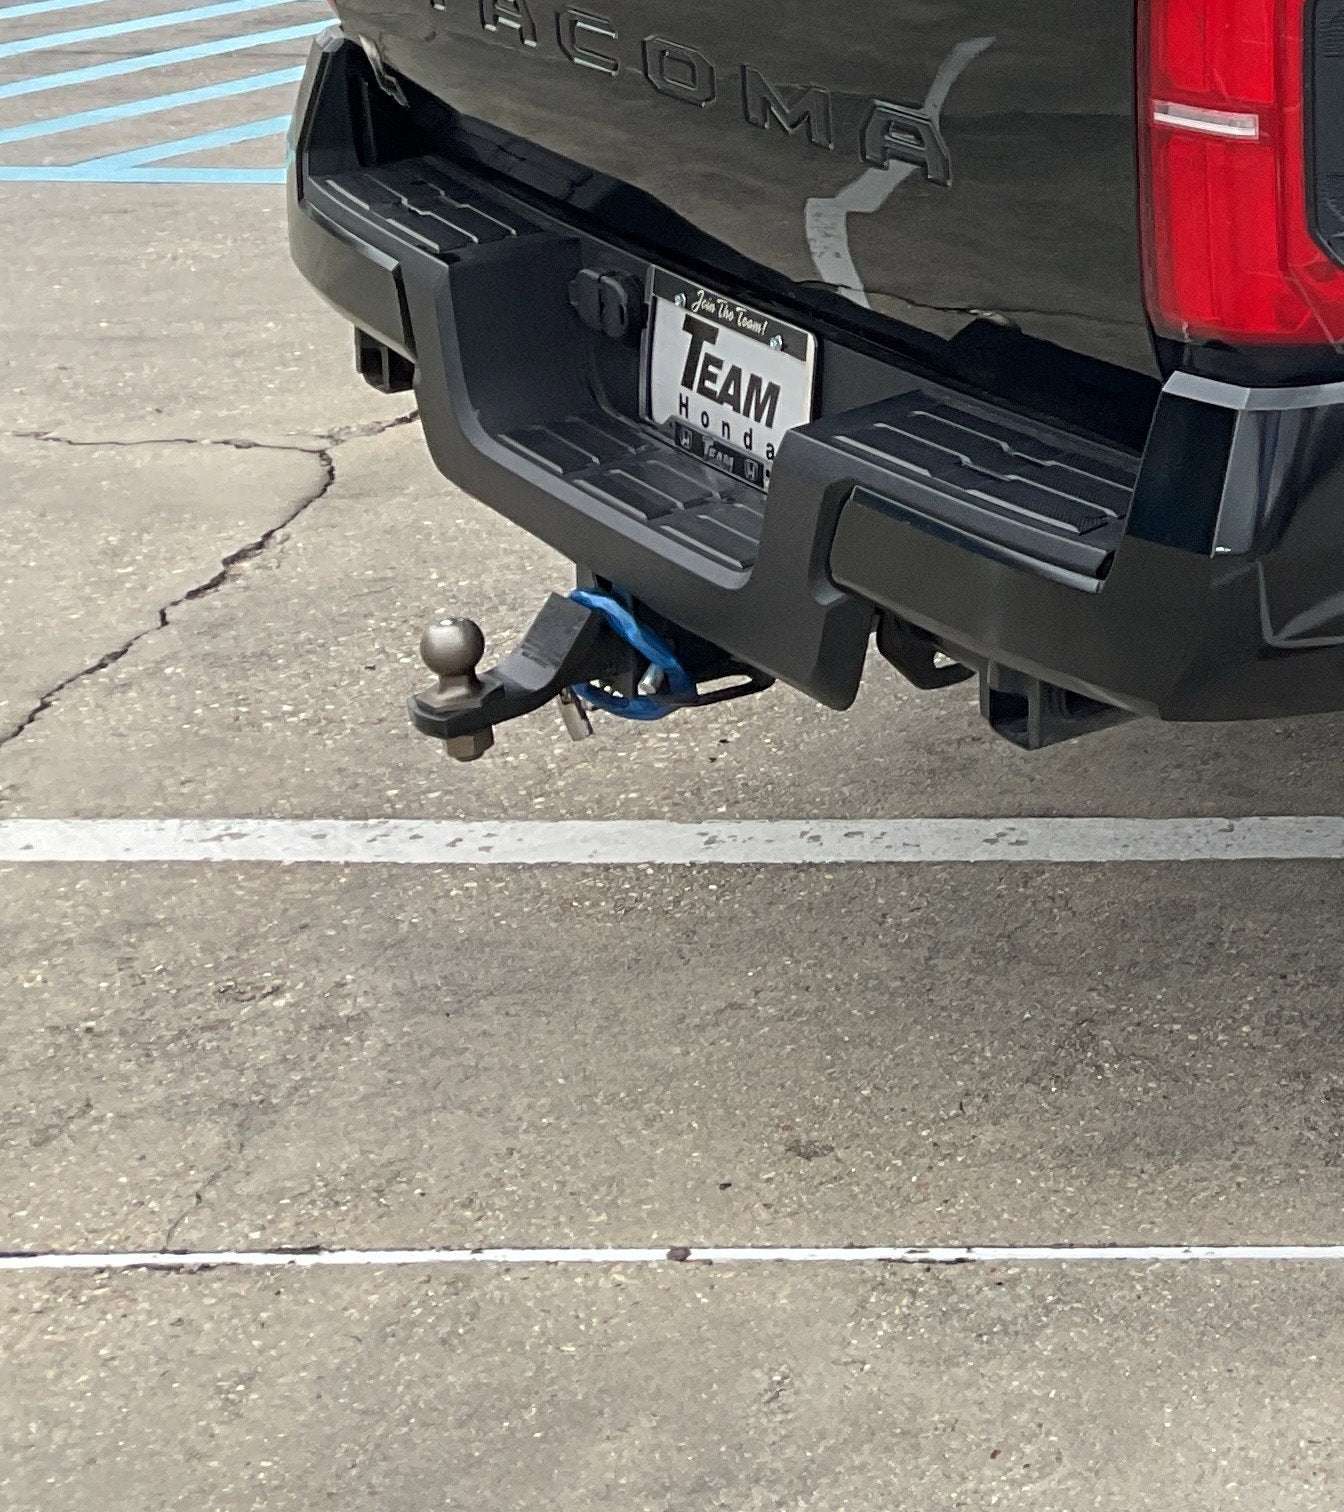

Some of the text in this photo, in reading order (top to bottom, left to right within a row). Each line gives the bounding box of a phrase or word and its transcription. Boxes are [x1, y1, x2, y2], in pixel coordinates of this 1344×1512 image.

[691, 290, 715, 313] Join
[716, 298, 735, 321] The
[681, 314, 781, 429] TEAM
[679, 392, 775, 460] Honda
[702, 438, 735, 472] TEAM
